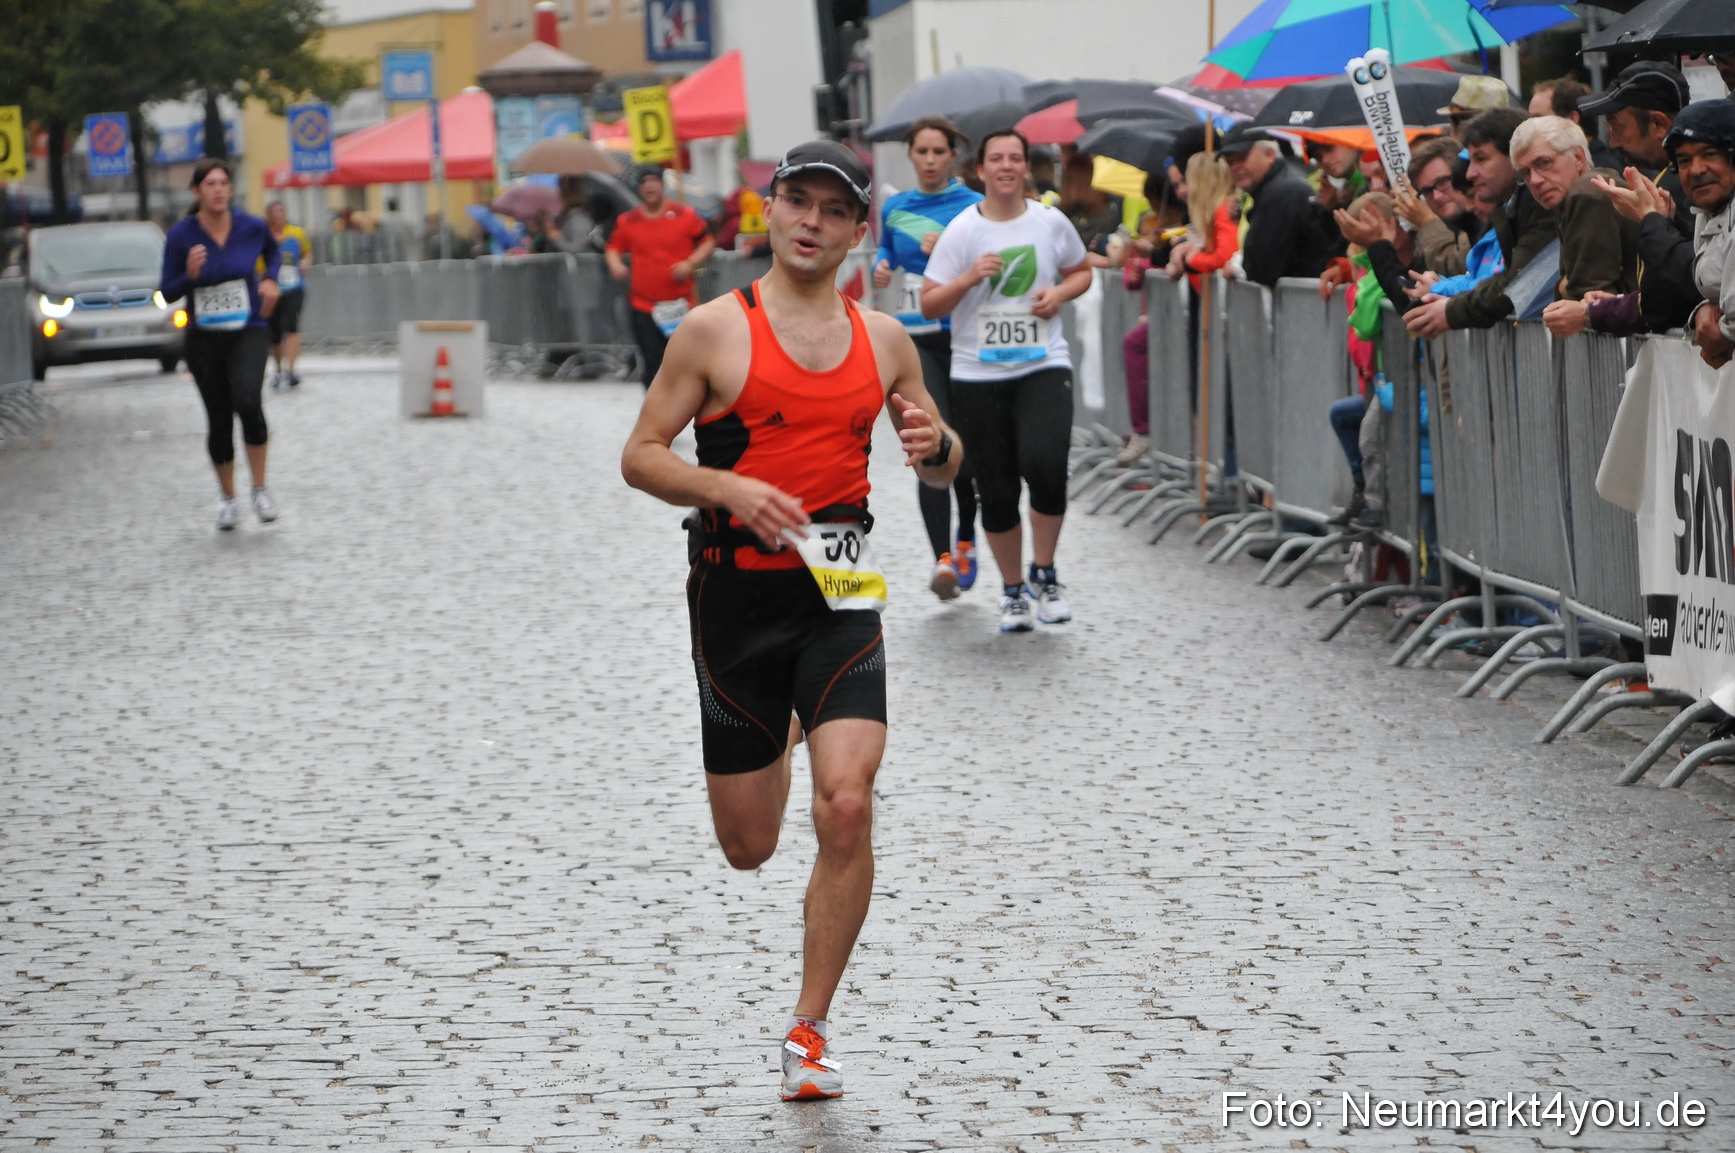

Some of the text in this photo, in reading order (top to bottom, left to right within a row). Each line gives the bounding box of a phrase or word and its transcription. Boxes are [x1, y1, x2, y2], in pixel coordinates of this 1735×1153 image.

[639, 110, 664, 143] D
[985, 321, 1038, 344] 2051
[1645, 614, 1668, 638] ten
